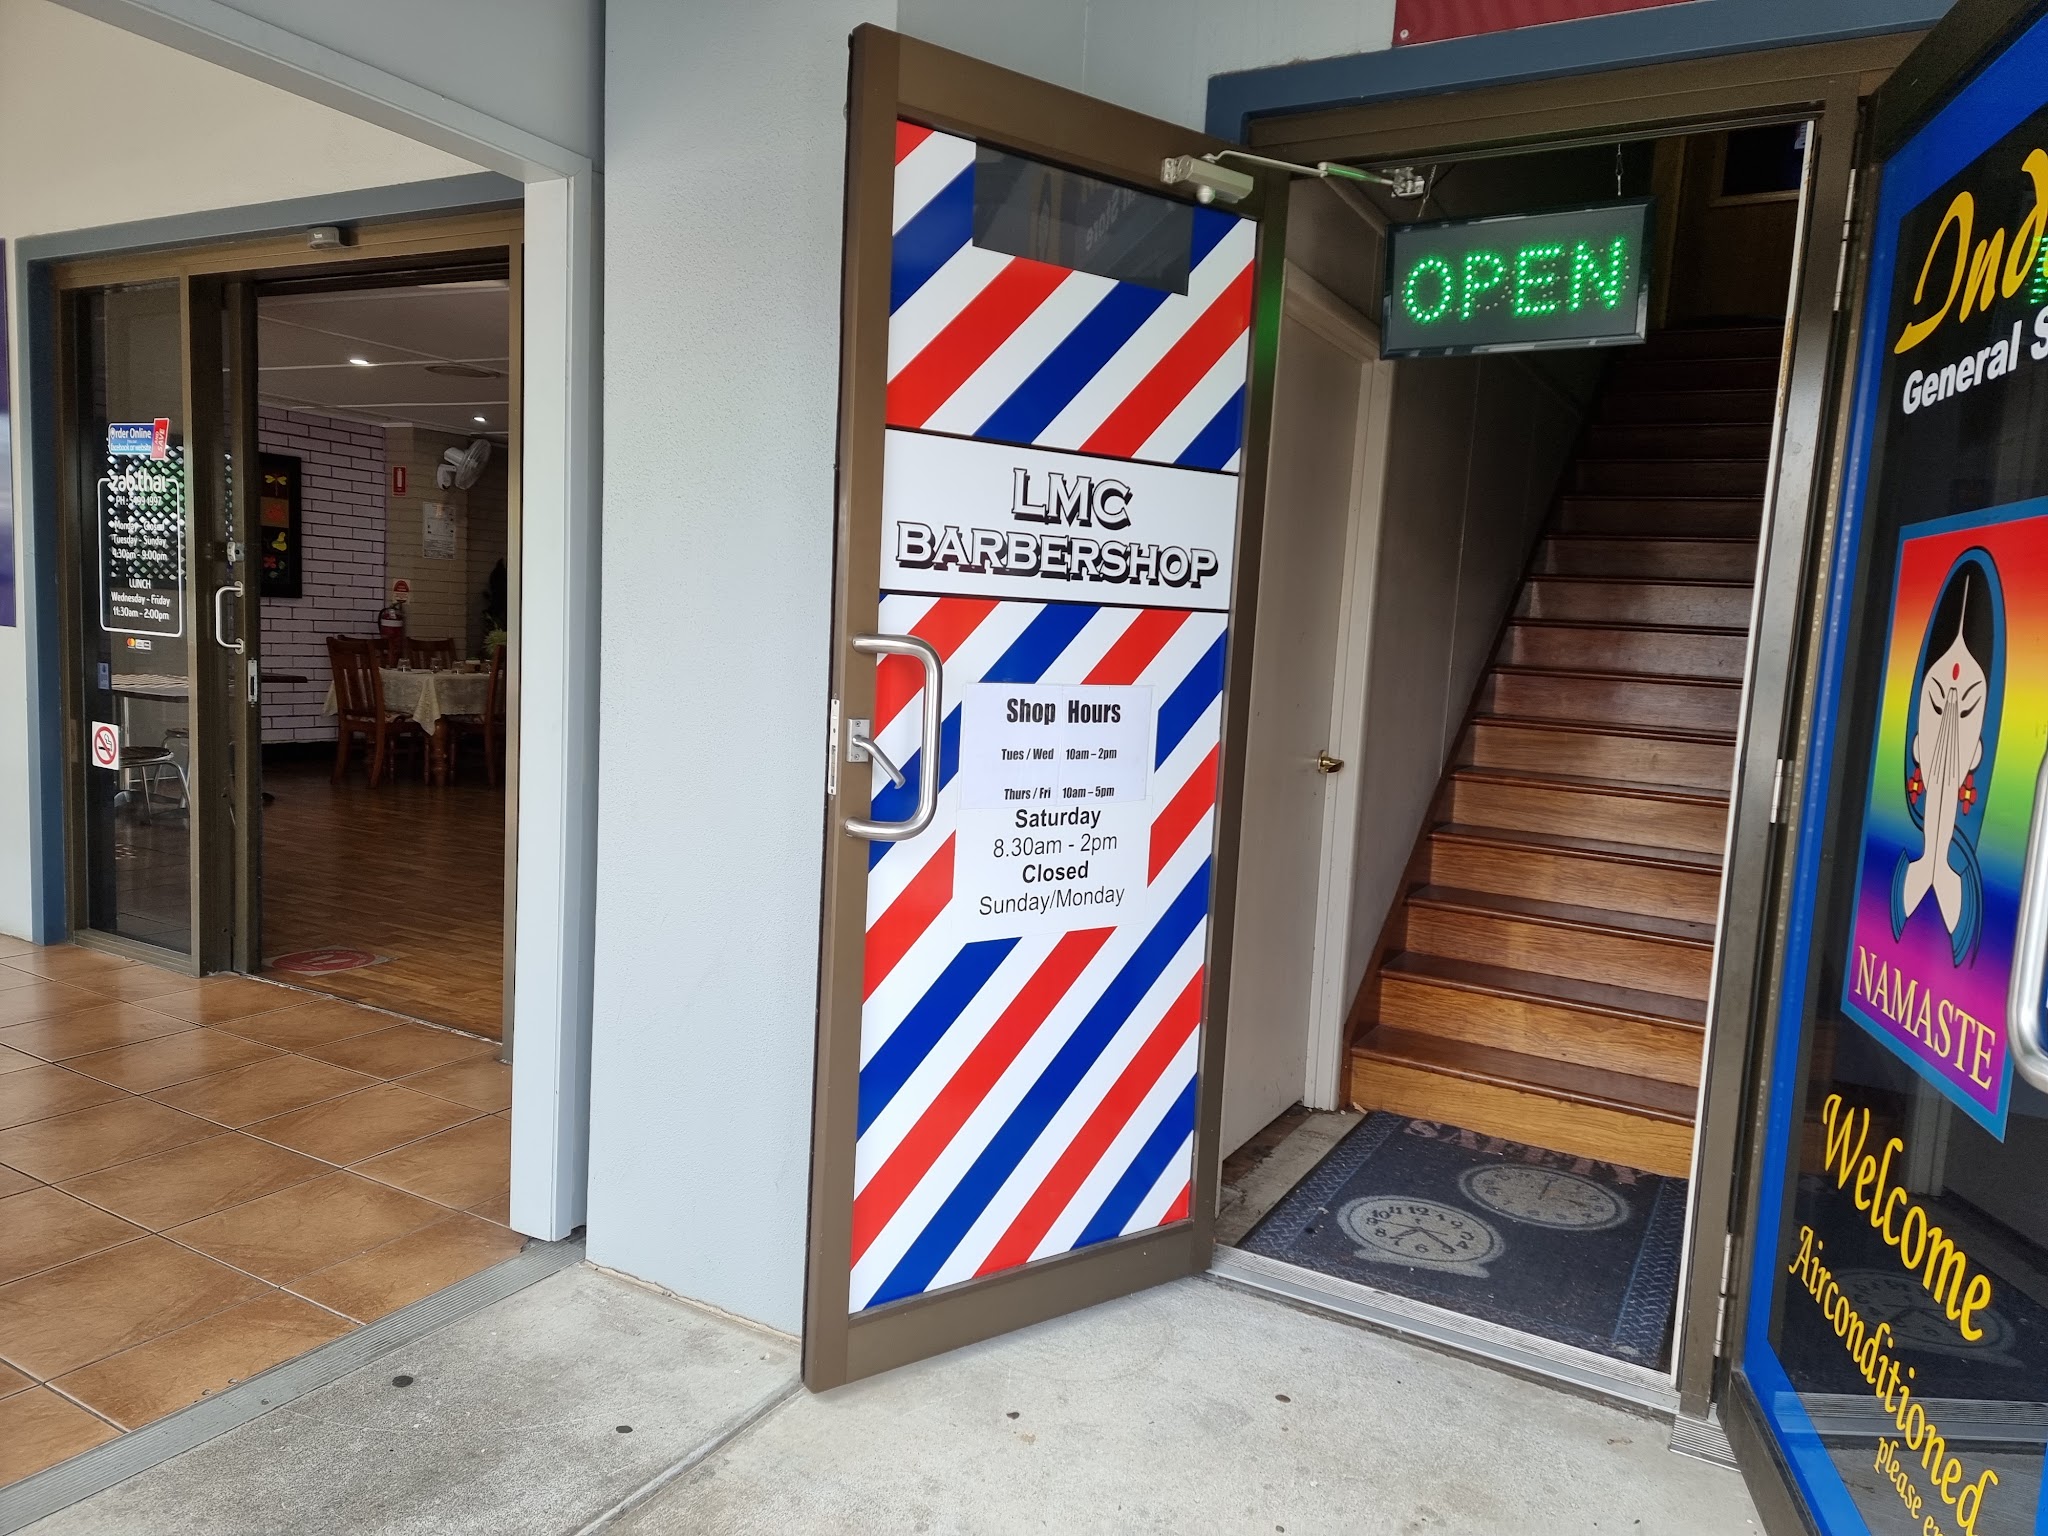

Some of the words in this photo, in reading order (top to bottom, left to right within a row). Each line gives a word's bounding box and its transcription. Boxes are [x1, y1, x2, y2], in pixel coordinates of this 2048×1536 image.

[1404, 236, 1628, 323] OPEN
[1903, 319, 2023, 415] General
[110, 427, 129, 440] Order
[129, 427, 152, 439] Online
[1012, 467, 1133, 530] LMC
[114, 520, 137, 532] Monday
[143, 520, 165, 531] Closed
[113, 534, 138, 546] Tuesday
[143, 535, 167, 547] Sunday
[112, 547, 136, 561] 4:30pm
[141, 549, 168, 564] 9:00pm
[896, 520, 1218, 588] BARBERSHOP
[128, 578, 152, 589] LUNCH
[111, 591, 146, 605] Wednesday
[151, 594, 171, 607] Friday
[113, 606, 139, 618] 11:30am
[144, 608, 170, 622] 2:00pm
[1006, 698, 1056, 725] Shop
[1067, 700, 1121, 724] Hours
[1001, 749, 1024, 760] Tues
[1032, 748, 1054, 760] Wed
[1066, 748, 1089, 760] 10am
[1098, 748, 1117, 761] 2pm
[1004, 788, 1031, 800] Thurs
[1039, 787, 1051, 799] Fri
[1062, 786, 1086, 799] 10am
[1095, 785, 1115, 798] 5pm
[1015, 806, 1101, 829] Saturday
[993, 836, 1062, 858] 8.30am
[1080, 833, 1118, 855] 2pm
[1022, 860, 1089, 884] Closed
[979, 885, 1125, 916] Sunday/Monday
[1855, 945, 1996, 1090] NAMASTE
[1823, 1093, 1992, 1341] Welcome
[1789, 1225, 1999, 1536] Airconditioned
[1873, 1437, 1922, 1519] please
